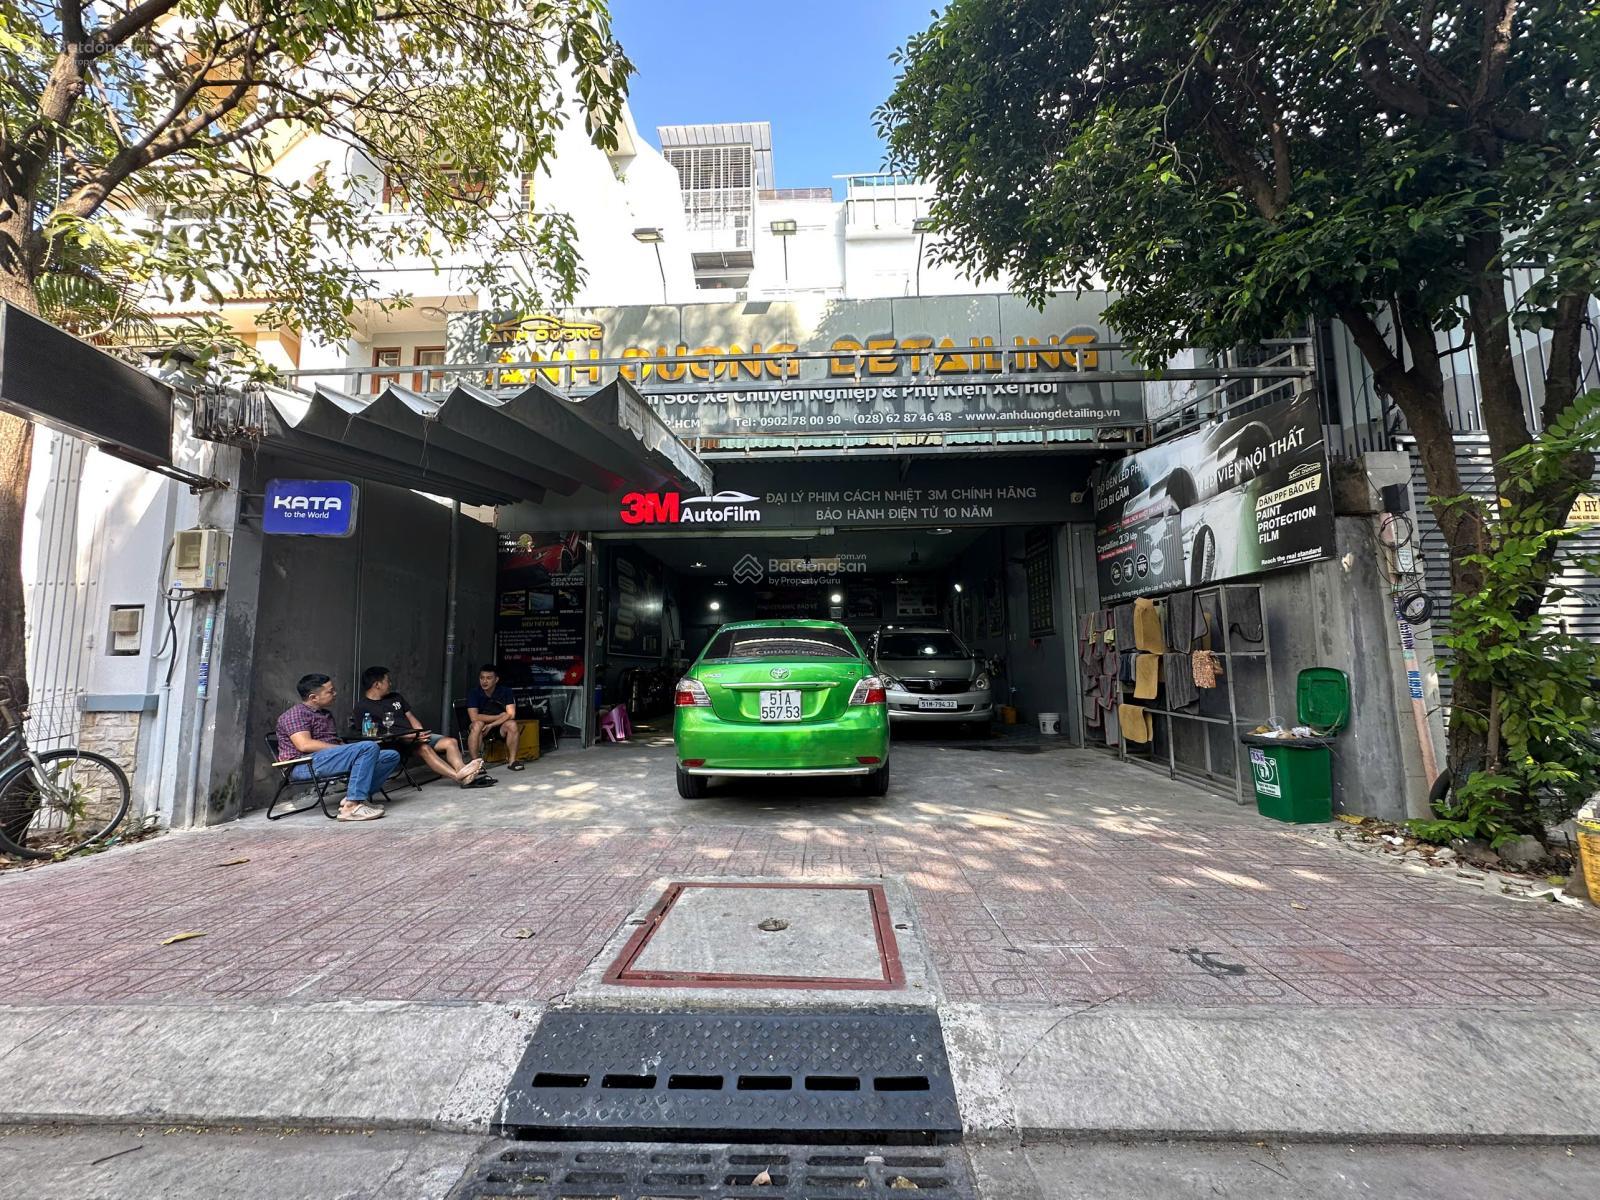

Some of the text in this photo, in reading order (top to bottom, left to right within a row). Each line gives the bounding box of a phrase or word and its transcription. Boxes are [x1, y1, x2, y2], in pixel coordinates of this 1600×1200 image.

[831, 335, 1097, 375] DETAILING
[882, 386, 898, 398] &
[735, 418, 757, 427] Tel:
[760, 417, 788, 426] 0902
[792, 416, 806, 425] 78
[809, 416, 823, 425] 00
[827, 415, 841, 424] 90
[853, 412, 883, 425] (028)
[886, 413, 900, 423] 62
[903, 413, 917, 422] 87
[920, 412, 934, 422] 46
[937, 412, 952, 421] 48
[965, 407, 1120, 421] www.anhduongdetailing.vn
[1245, 447, 1267, 471] NỘI
[1269, 426, 1305, 458] THẤT
[273, 495, 342, 511] KATA
[766, 485, 1037, 505] ĐẠI LÝ PHIM CÁCH NHIỆT 3M CHÍNH HÃNG
[1275, 490, 1287, 502] PPF
[307, 511, 329, 519] World
[620, 491, 761, 525] 3M AutoFilm
[816, 503, 993, 521] BẢO HÀNH ĐIỆN TỬ 10 NĂM
[1256, 504, 1282, 521] PAINT
[1257, 505, 1317, 533] PROTECTION
[1259, 529, 1279, 544] FILM
[1261, 557, 1276, 565] Reach
[1286, 552, 1296, 561] real
[1297, 545, 1322, 558] standard
[770, 692, 792, 706] 51A
[761, 705, 800, 719] 557.53
